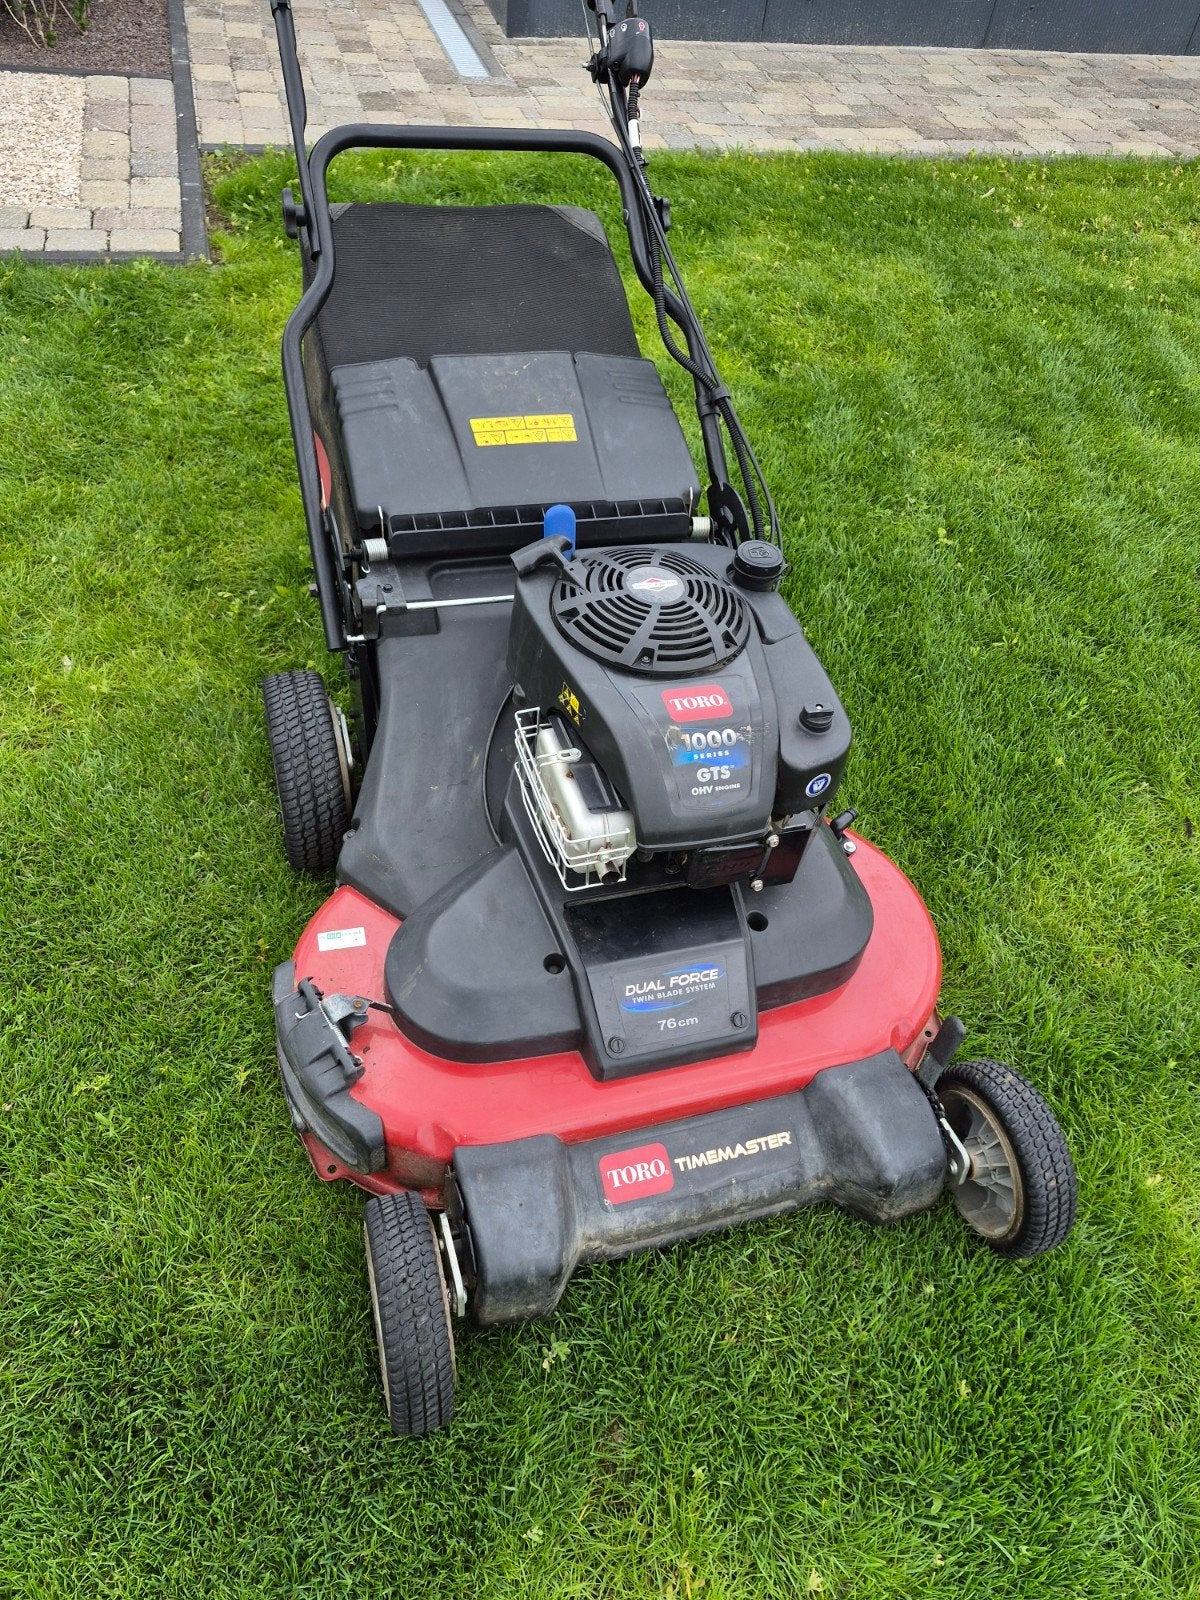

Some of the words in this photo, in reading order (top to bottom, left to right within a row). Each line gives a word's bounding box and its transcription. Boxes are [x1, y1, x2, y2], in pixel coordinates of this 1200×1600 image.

[669, 694, 724, 711] TORO
[680, 728, 737, 752] 1000
[693, 750, 730, 760] SERIES
[696, 765, 731, 783] GTS
[691, 785, 713, 796] OHV
[715, 783, 741, 792] ENGINE
[625, 979, 666, 997] DUAL
[669, 968, 719, 988] FORCE
[632, 994, 655, 1004] TWIN
[657, 988, 683, 999] BLADE
[685, 982, 716, 994] SYSTEM
[607, 1158, 666, 1188] TORO
[674, 1131, 792, 1172] TIMEMASTER
